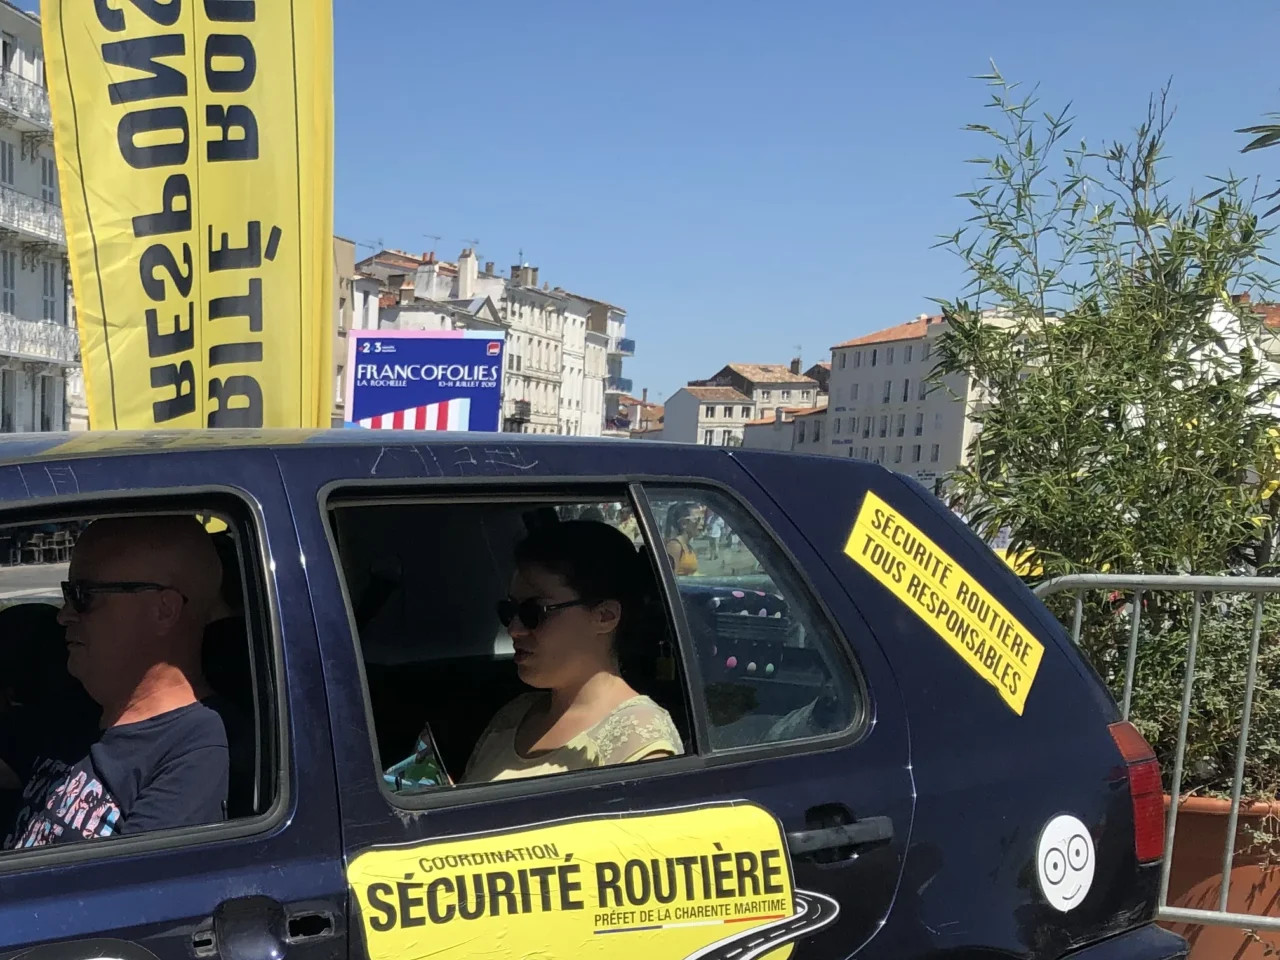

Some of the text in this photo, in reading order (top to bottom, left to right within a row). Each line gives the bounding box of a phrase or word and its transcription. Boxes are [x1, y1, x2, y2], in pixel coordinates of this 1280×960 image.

[357, 364, 499, 381] FRANCOFOLIES
[357, 379, 408, 387] LA ROCHELLE
[871, 508, 1033, 667] SÉCURITÉ ROUTIÈRE
[862, 533, 1022, 696] TOUS RESPONSABLES
[418, 843, 560, 873] COORDINATION
[368, 842, 784, 932] SÉCURITÉ ROUTIÈRE
[594, 898, 787, 927] PRÉFET DE LA CHARENTE MARITIME
